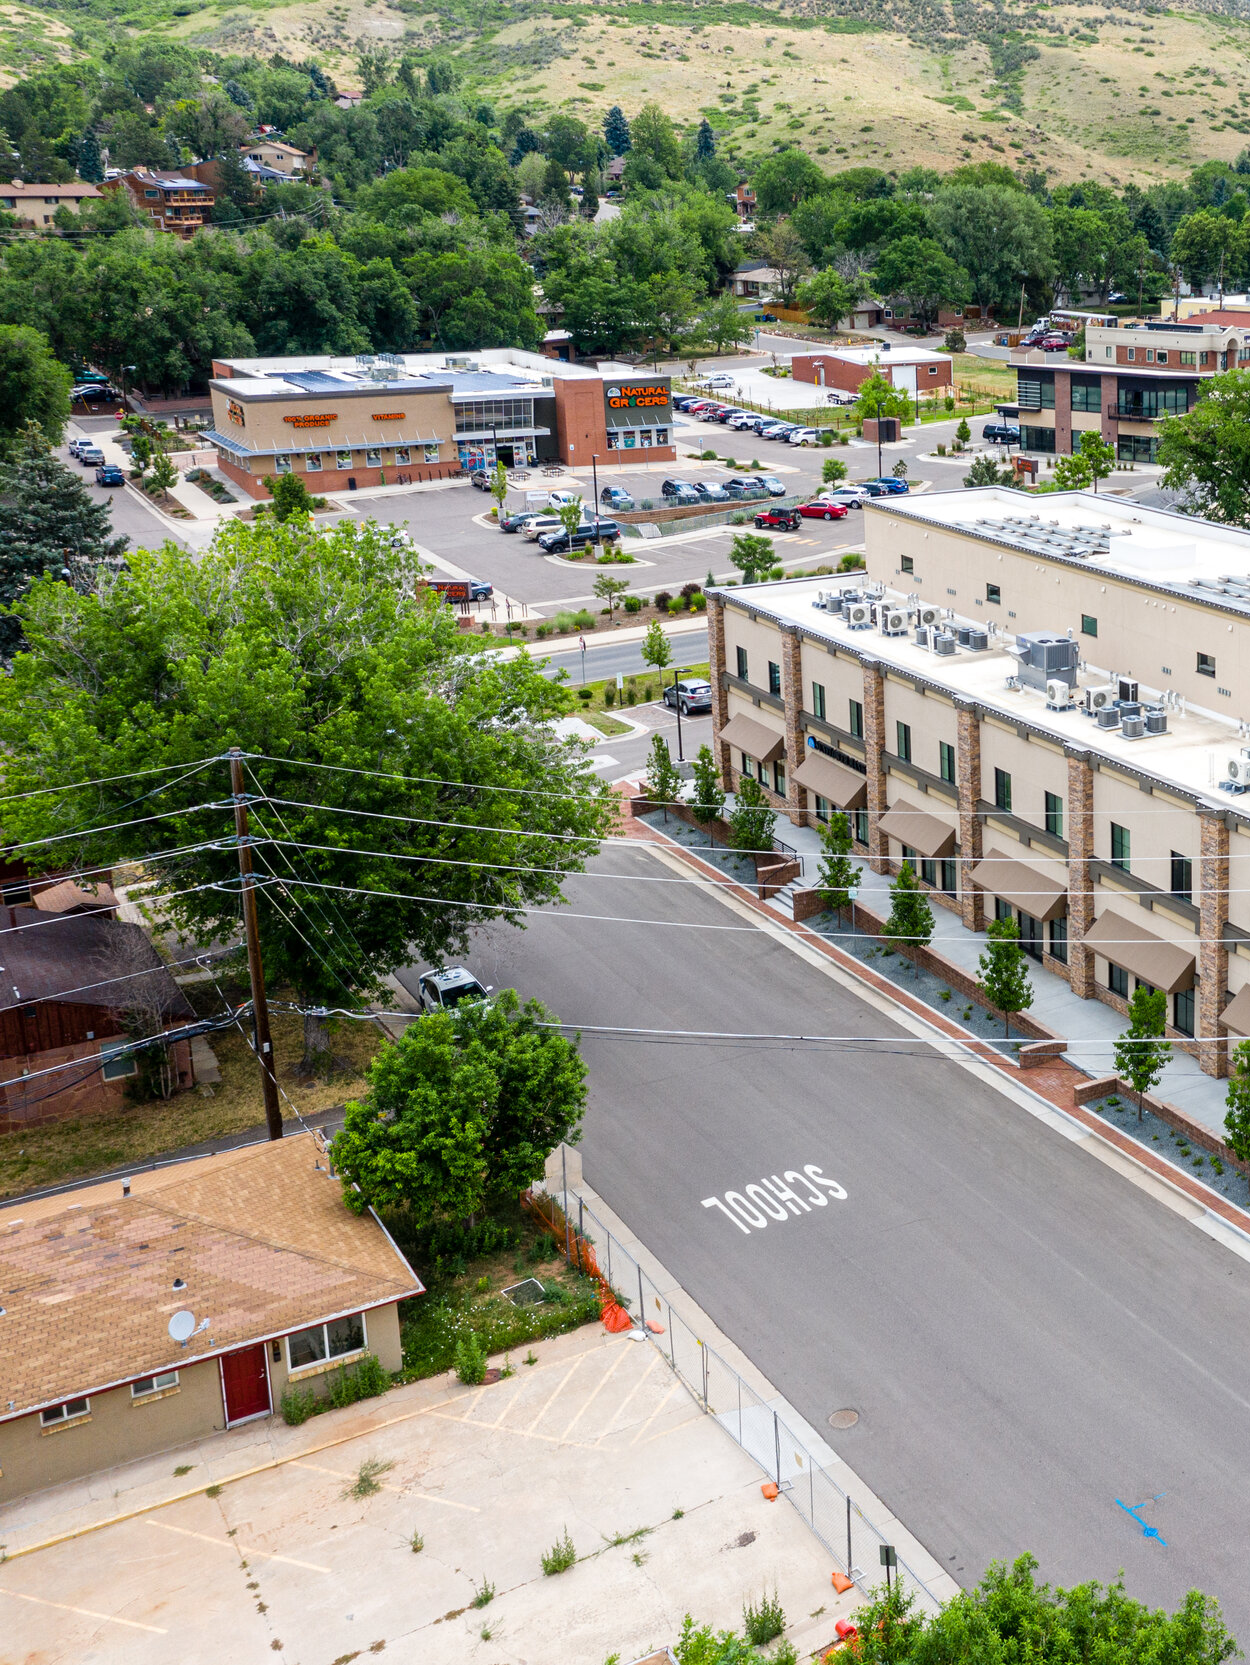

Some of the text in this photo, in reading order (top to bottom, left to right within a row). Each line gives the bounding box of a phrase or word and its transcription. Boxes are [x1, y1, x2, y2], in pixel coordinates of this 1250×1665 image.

[621, 386, 669, 396] NATURAL
[610, 396, 668, 408] GROCERS
[700, 1164, 848, 1235] SCHOOL
